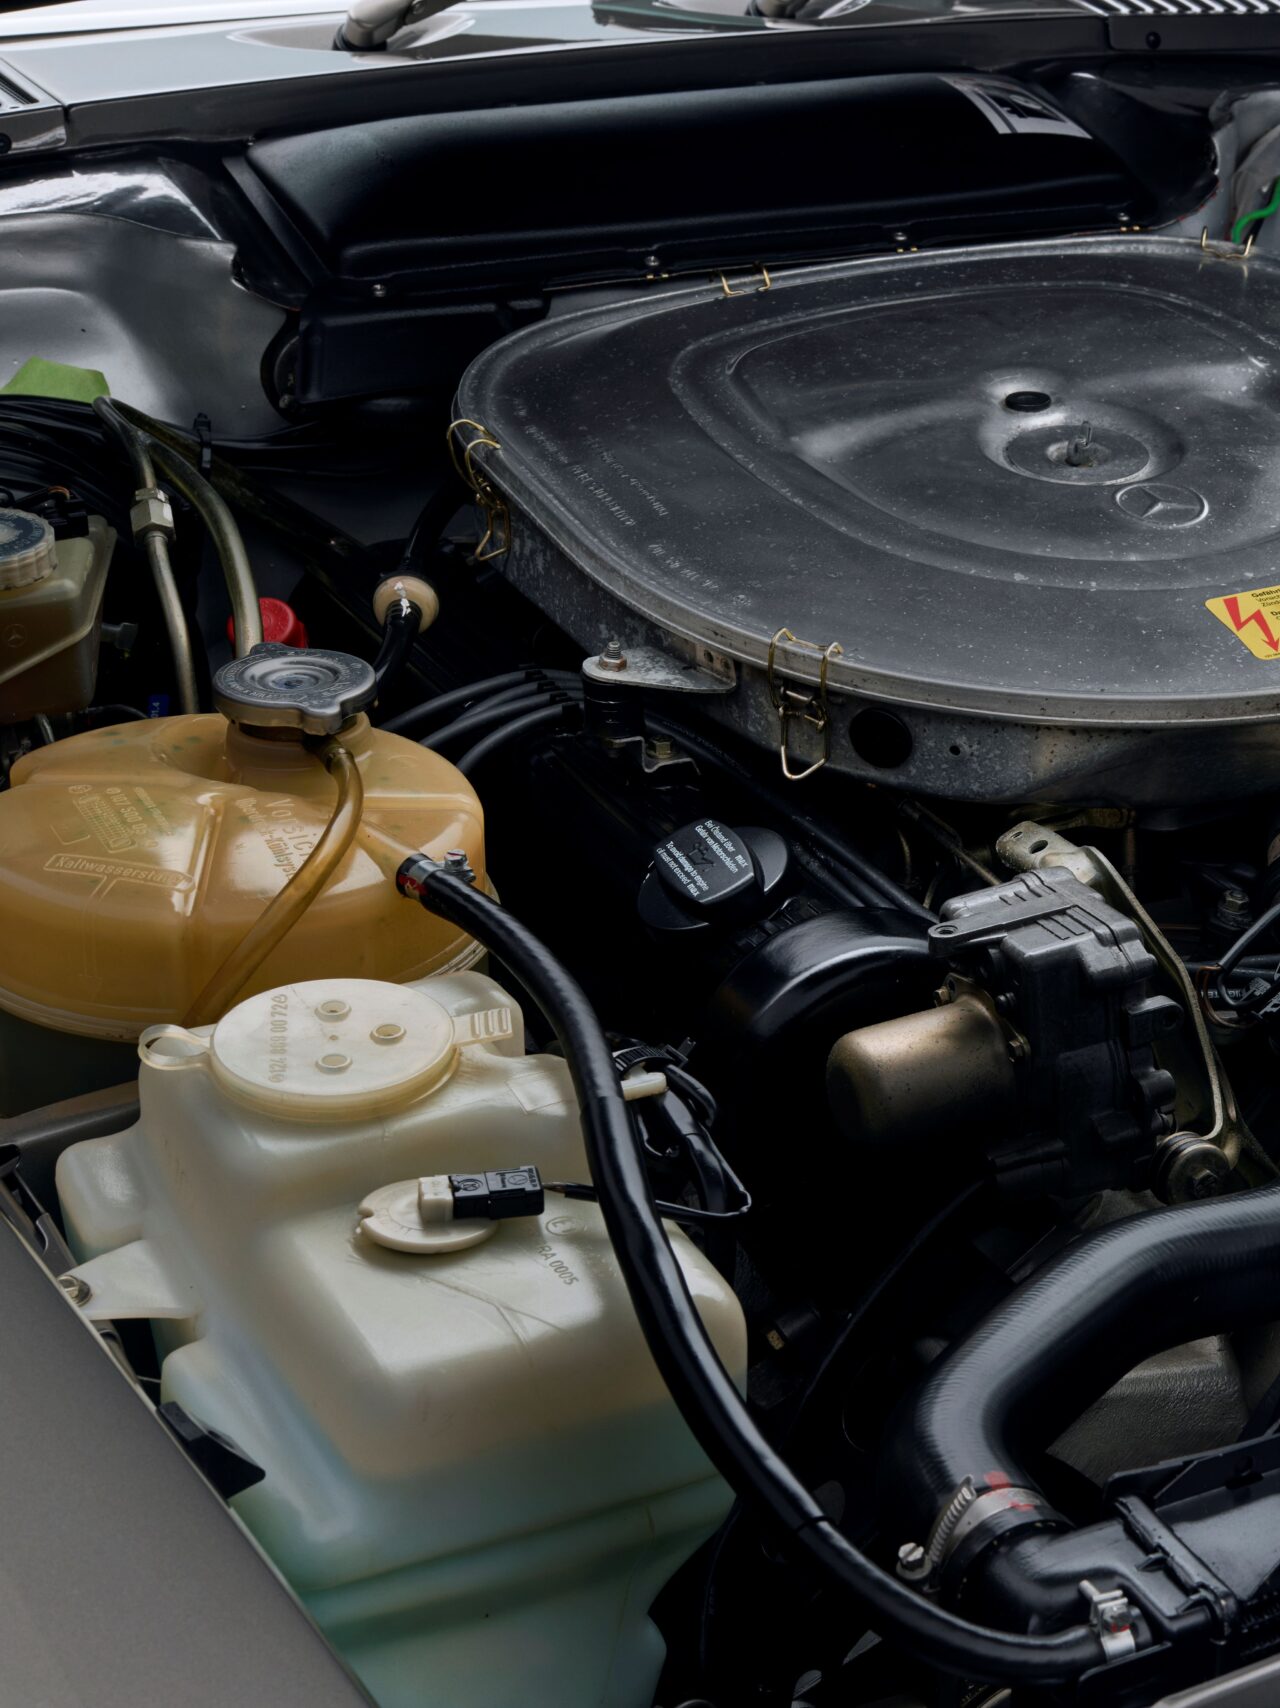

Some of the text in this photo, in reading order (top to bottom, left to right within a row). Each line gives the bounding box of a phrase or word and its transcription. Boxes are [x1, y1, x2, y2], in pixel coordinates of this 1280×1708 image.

[735, 855, 748, 867] max
[687, 883, 699, 896] max
[549, 1259, 579, 1285] 0005
